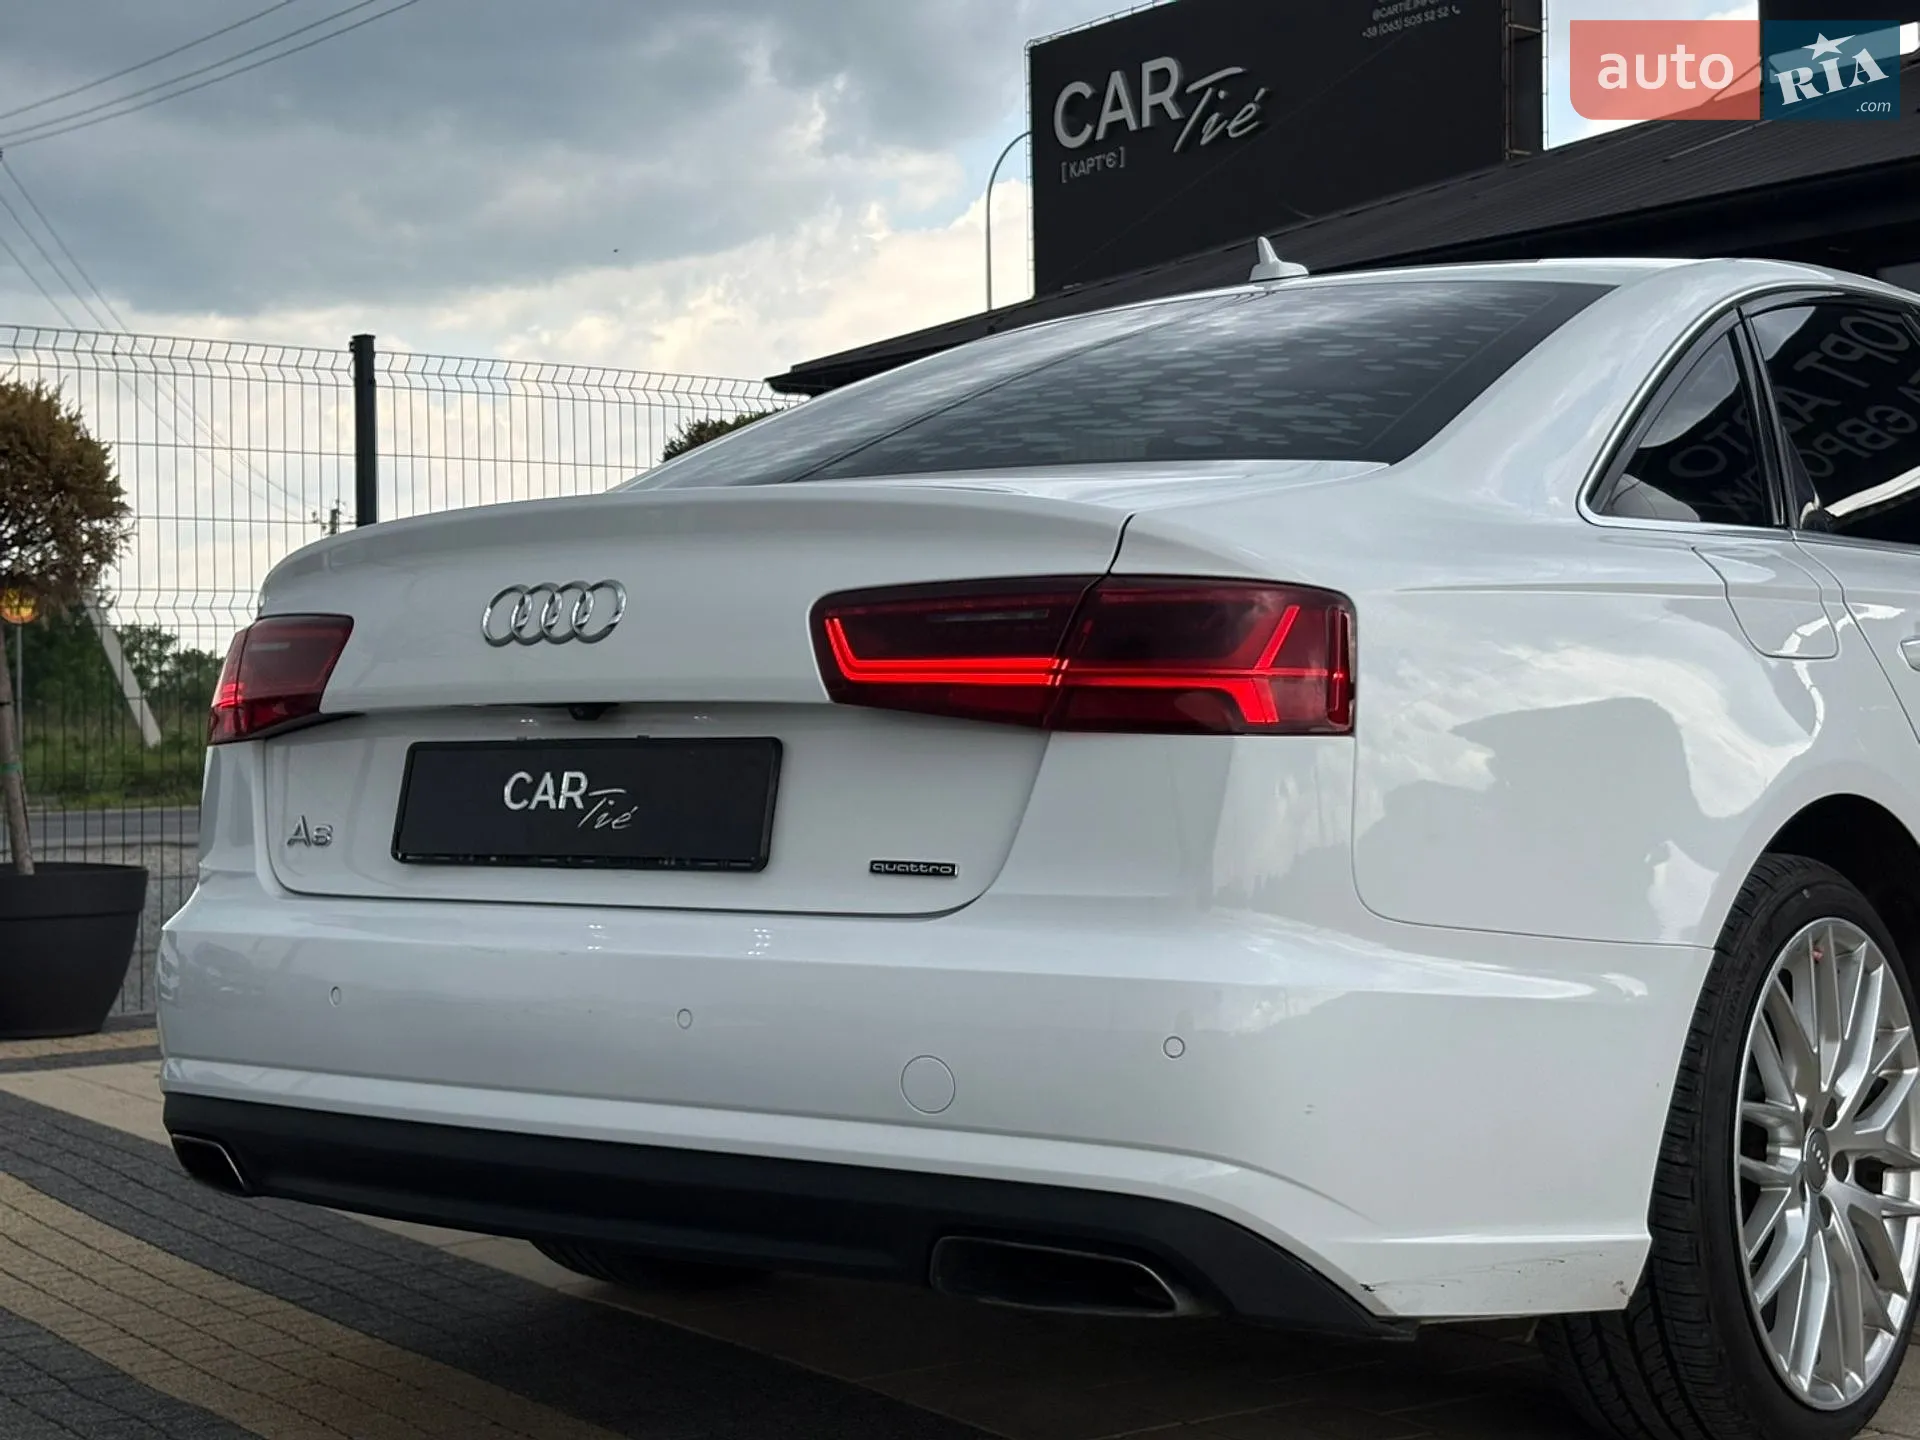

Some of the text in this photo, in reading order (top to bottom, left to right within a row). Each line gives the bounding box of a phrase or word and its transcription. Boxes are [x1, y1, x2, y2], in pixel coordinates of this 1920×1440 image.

[1054, 56, 1184, 149] CAR
[503, 771, 588, 811] CAR
[286, 814, 333, 848] A6
[872, 863, 953, 874] quattro
